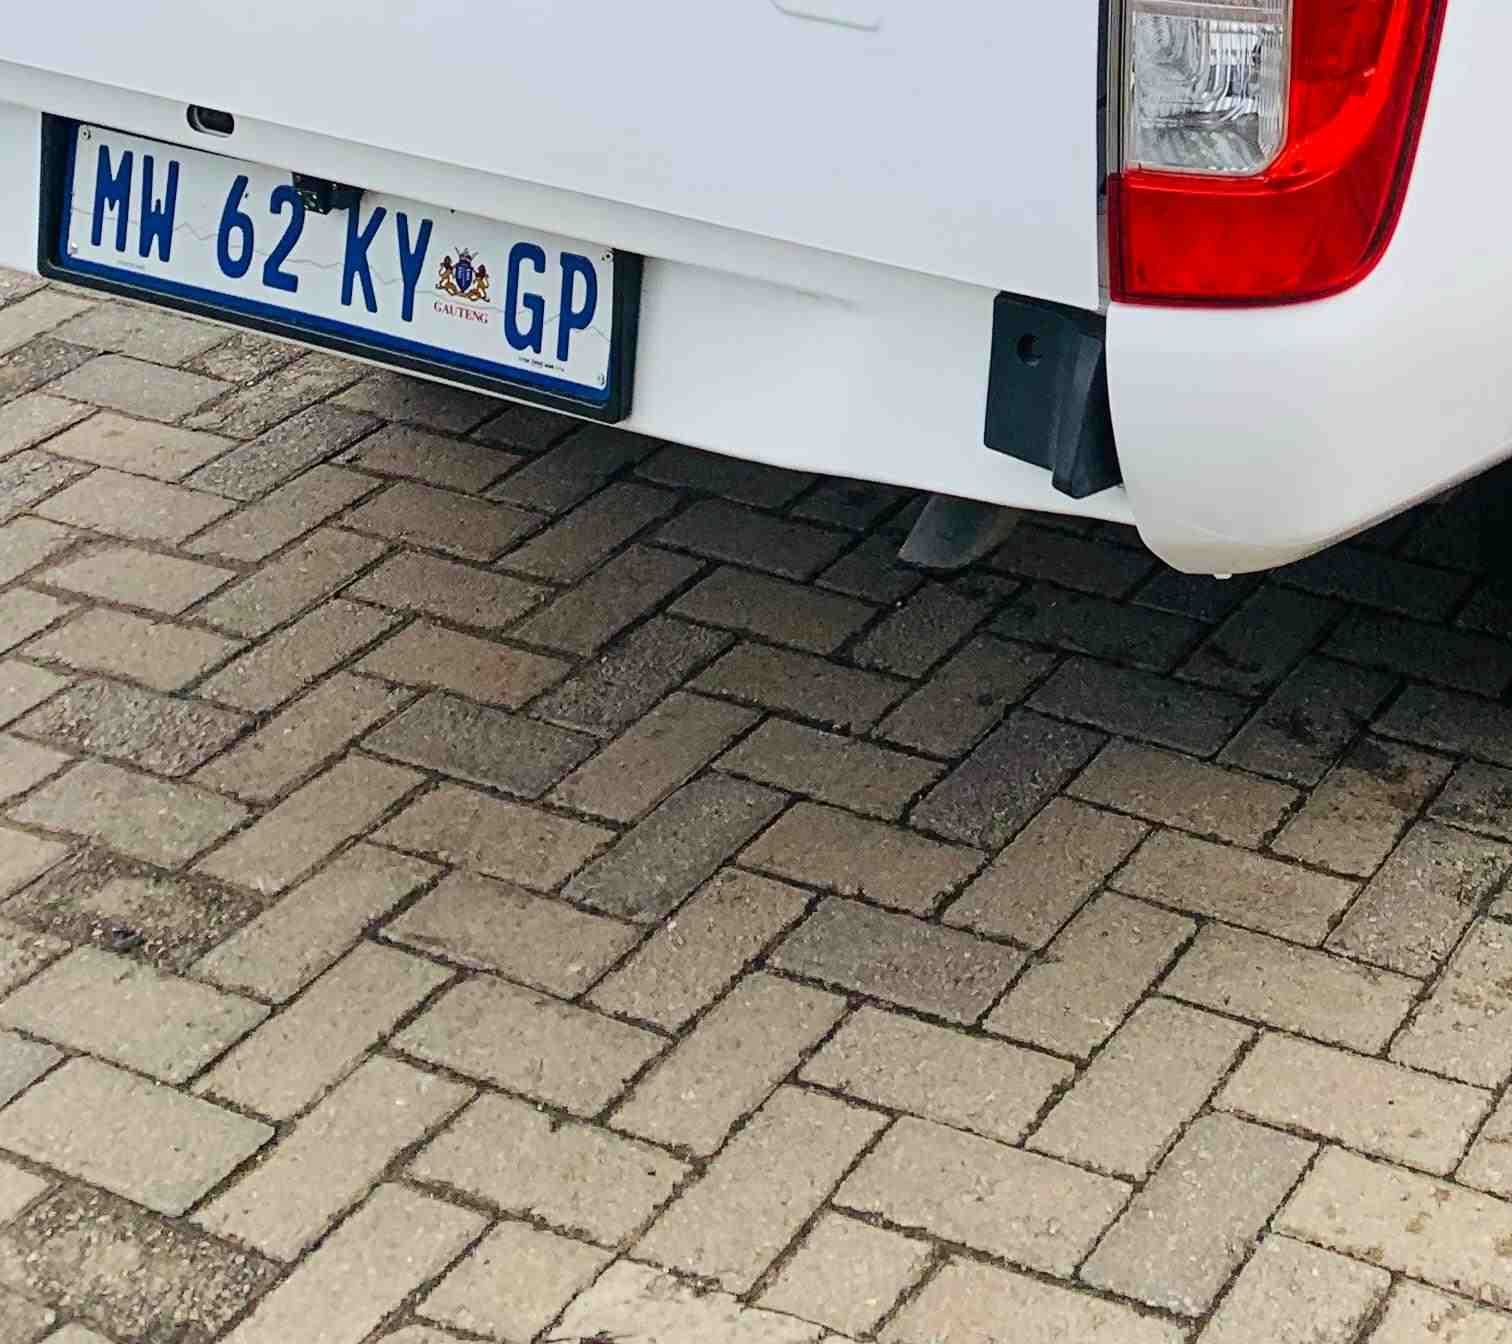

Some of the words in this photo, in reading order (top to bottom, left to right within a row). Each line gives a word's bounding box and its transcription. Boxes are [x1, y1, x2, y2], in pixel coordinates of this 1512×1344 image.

[91, 143, 180, 263] MW
[216, 174, 306, 293] 62
[340, 203, 433, 322] KY
[503, 241, 599, 362] GP
[433, 300, 489, 324] GAUTENG
